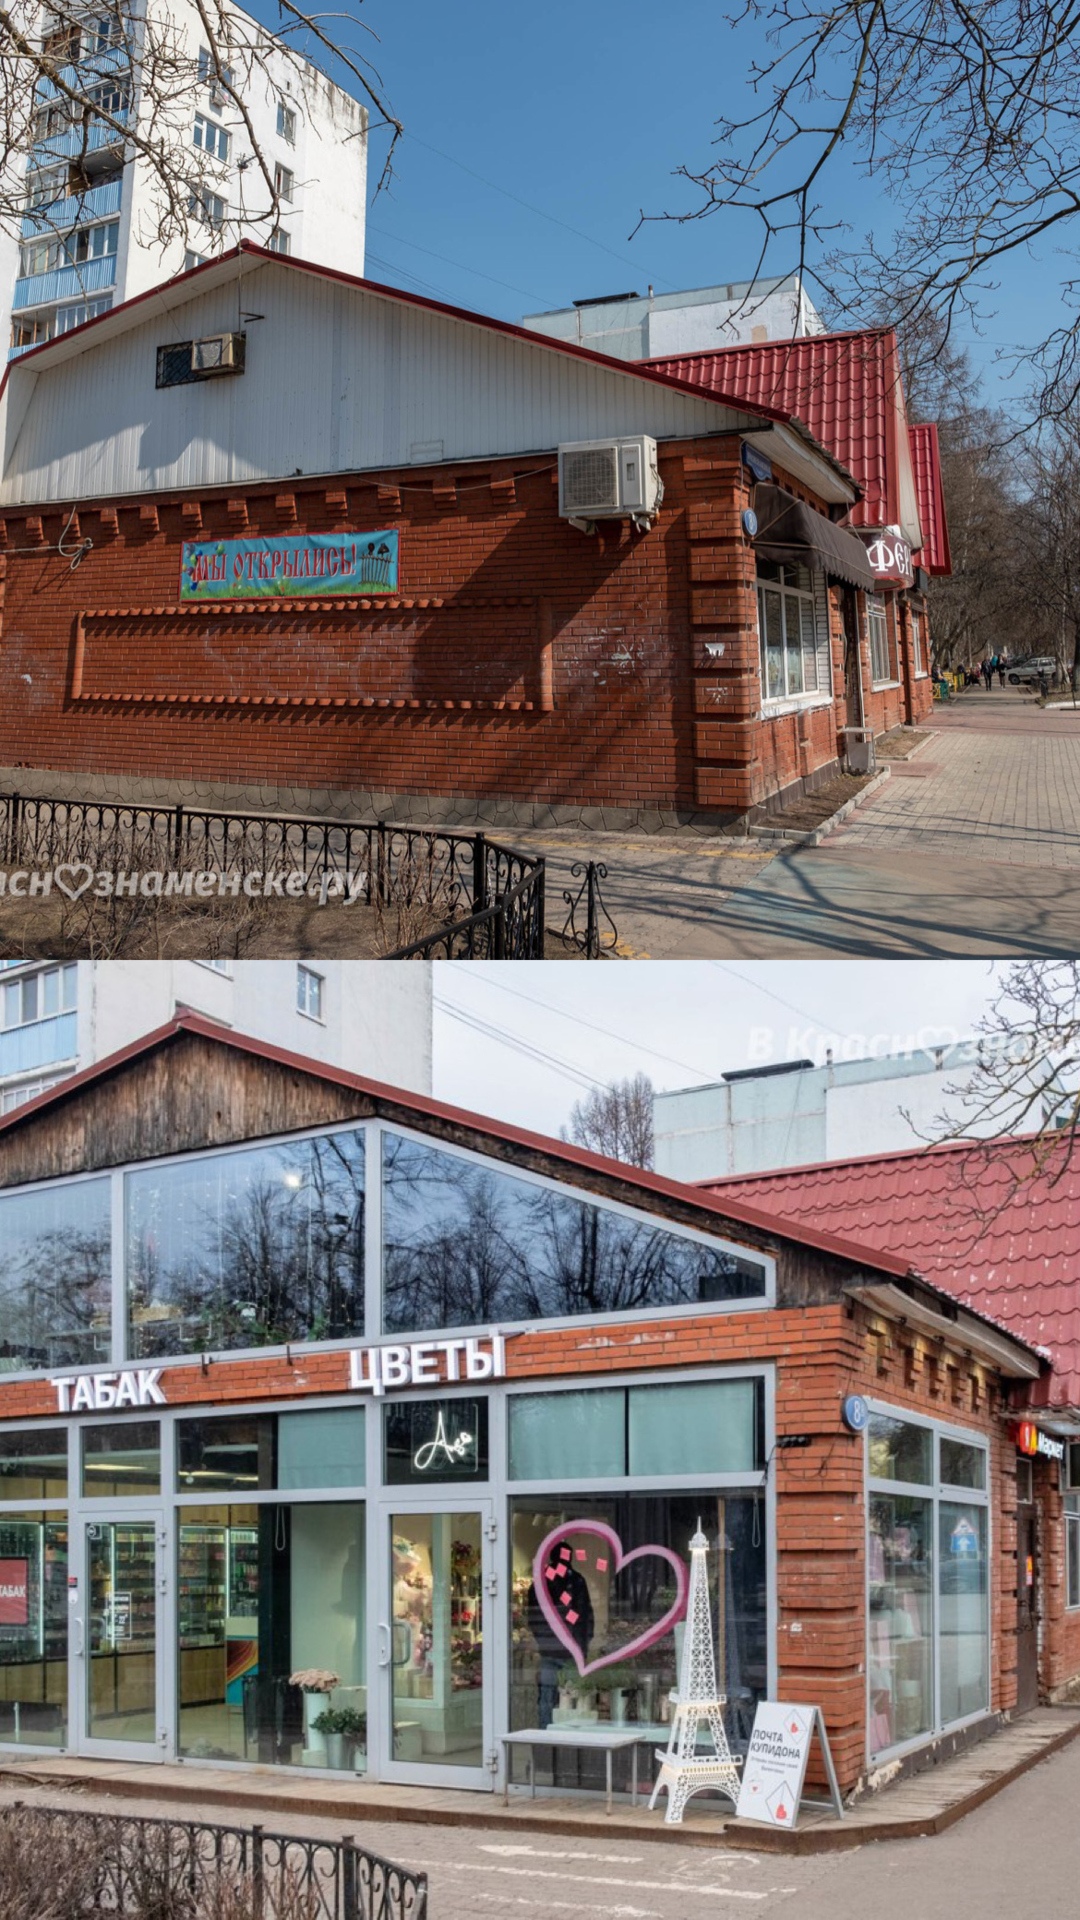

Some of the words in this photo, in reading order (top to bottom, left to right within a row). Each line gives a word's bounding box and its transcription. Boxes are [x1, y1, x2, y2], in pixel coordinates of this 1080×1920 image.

[192, 553, 227, 582] МЫ
[233, 543, 358, 580] ОТКРЫЛИСЬ!
[350, 1335, 507, 1396] ЦВЕТЫ
[51, 1368, 168, 1412] ТАБАК
[750, 1742, 801, 1760] КУПИДОНА
[753, 1729, 783, 1744] ПОЧТА
